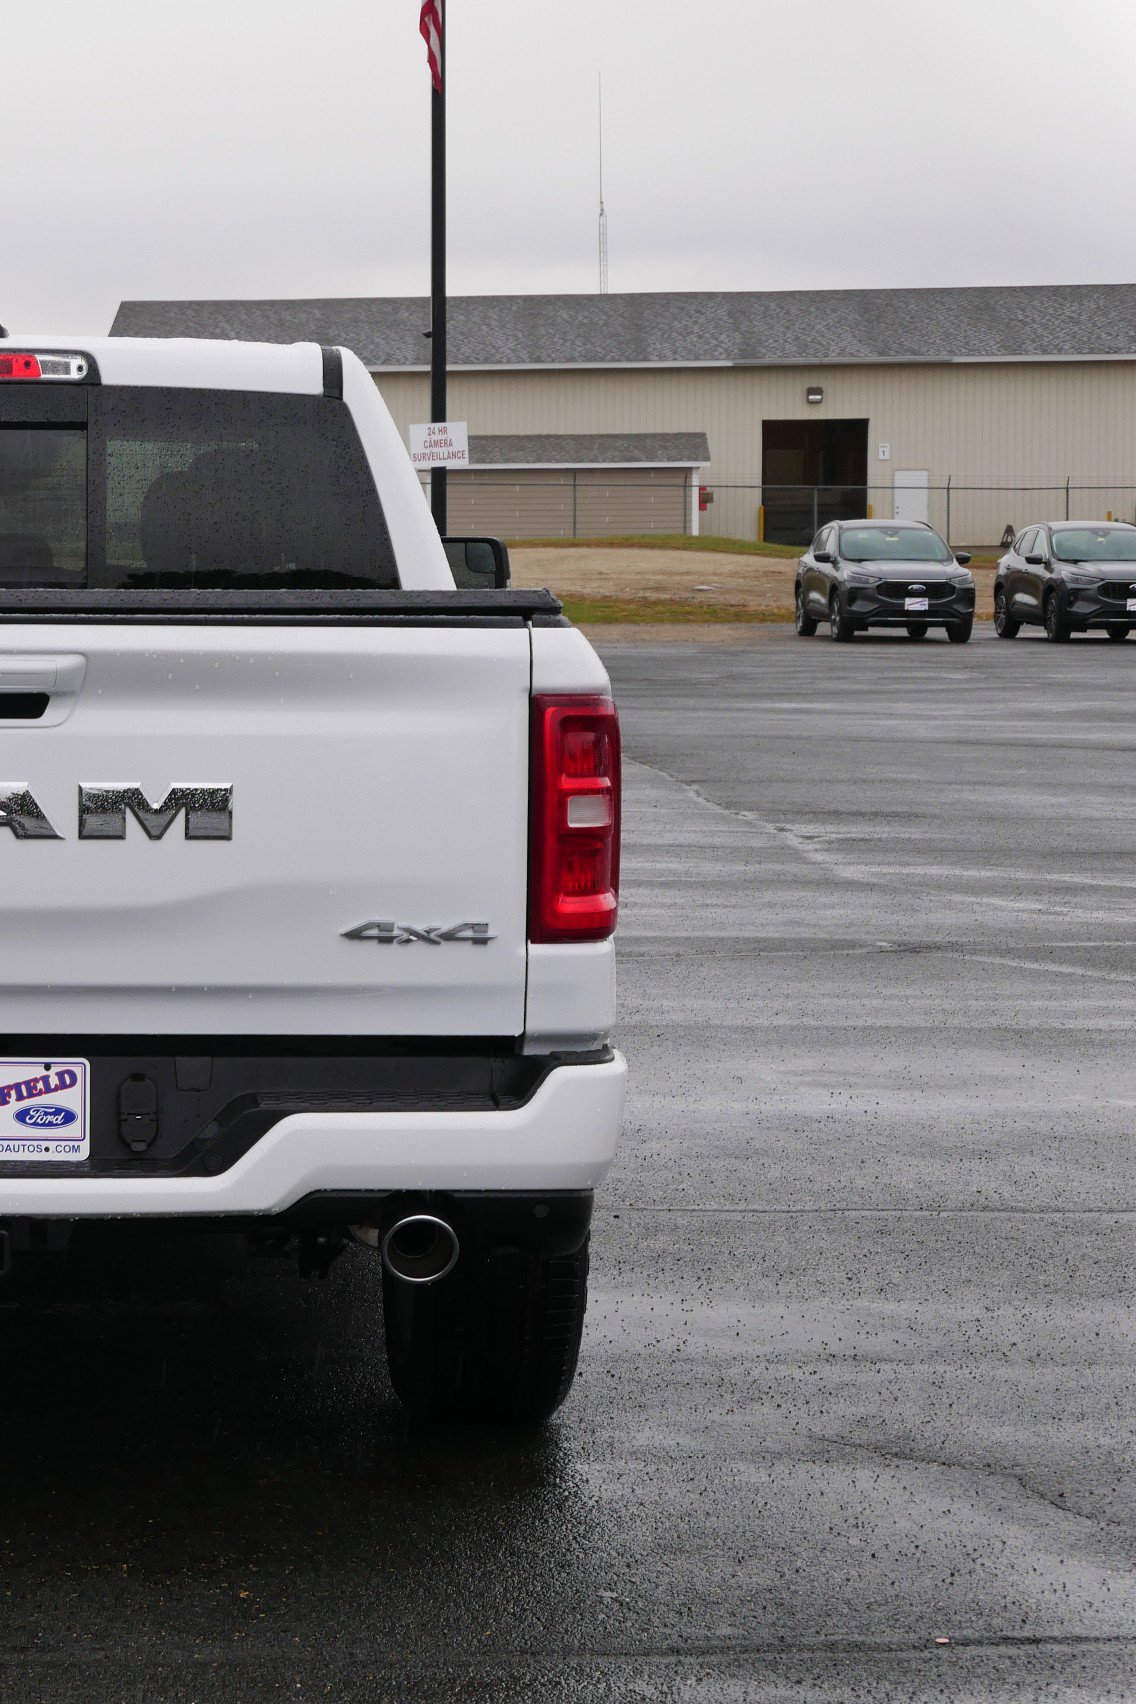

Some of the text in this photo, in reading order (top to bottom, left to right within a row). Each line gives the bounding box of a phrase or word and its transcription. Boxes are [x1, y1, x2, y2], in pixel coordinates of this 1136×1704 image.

[427, 426, 448, 436] 24 HR
[424, 438, 453, 449] CAMERA
[412, 450, 467, 462] SURVEILLANCE
[26, 1107, 66, 1125] Ford
